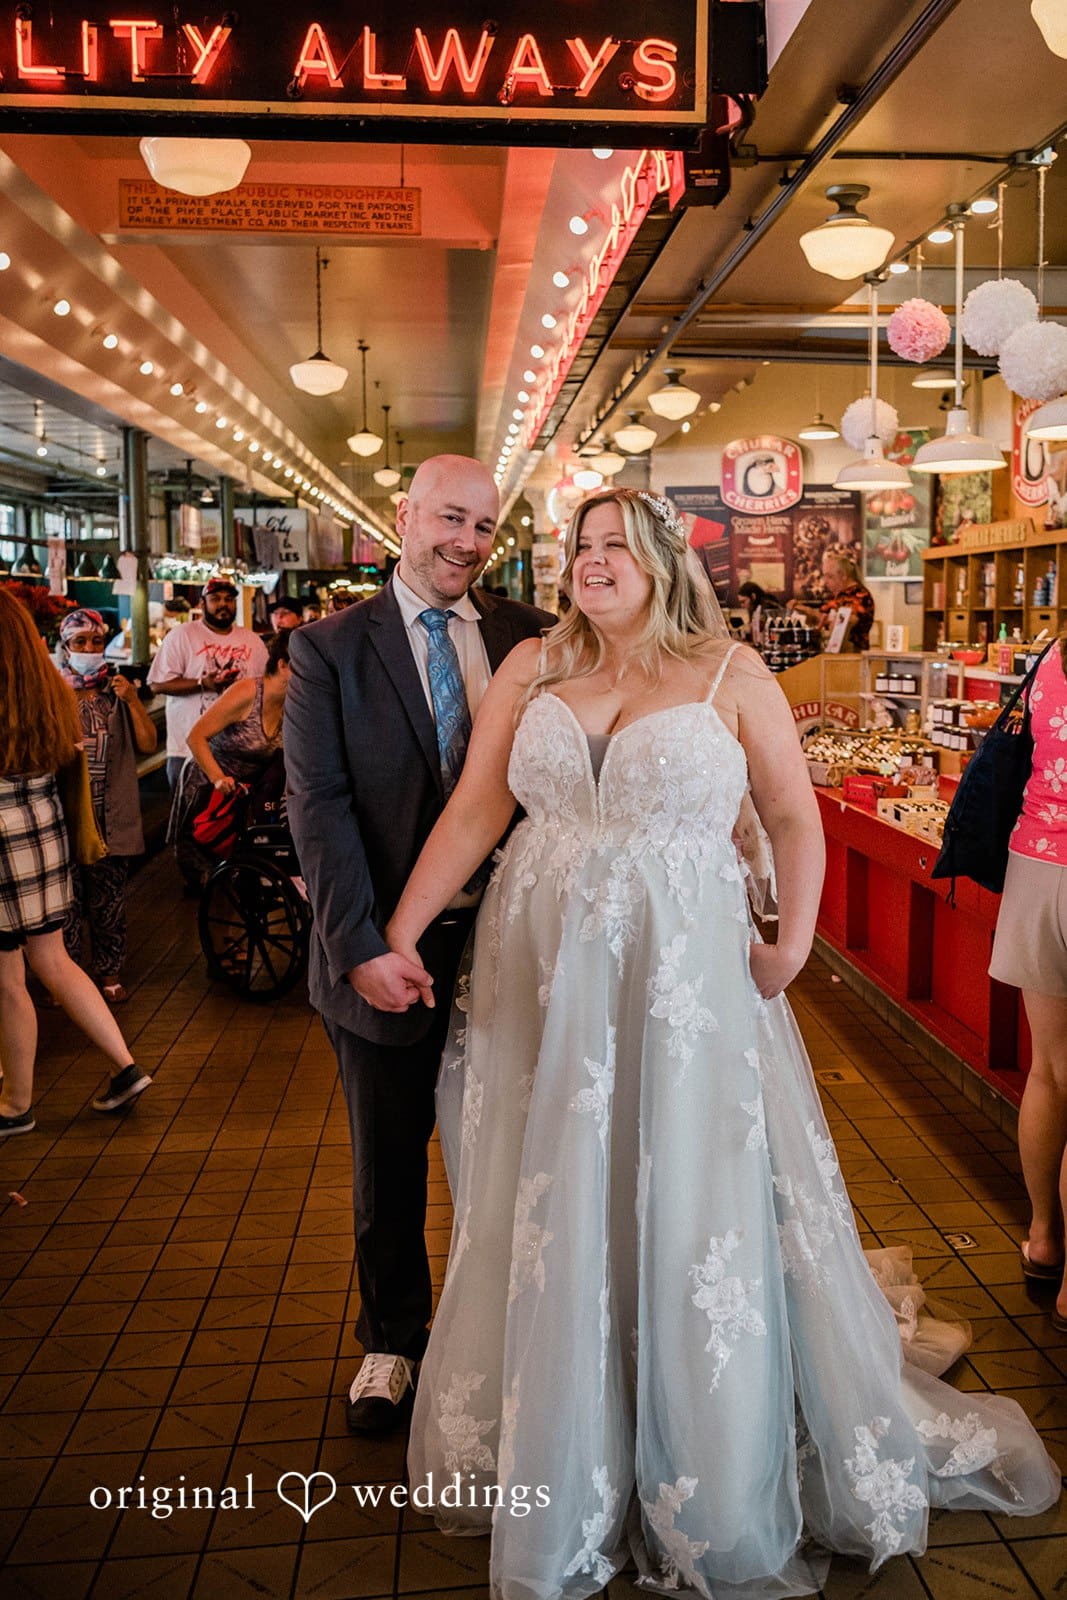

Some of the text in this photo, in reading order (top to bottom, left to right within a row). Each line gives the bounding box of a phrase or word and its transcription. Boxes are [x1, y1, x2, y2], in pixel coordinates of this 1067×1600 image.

[0, 18, 679, 102] LITY ALWAYS
[127, 184, 158, 195] THIS
[237, 186, 289, 199] PUBLIC
[296, 187, 414, 201] THOROUGHFARE
[127, 196, 415, 212] IT IS A PRIVATE WALK RESERVED FOR THE PATRONS
[127, 206, 143, 214] OF
[149, 206, 171, 215] THE
[176, 207, 205, 216] PIKE
[211, 208, 252, 217] PLACE
[257, 209, 299, 218] PUBLIC
[304, 210, 348, 219] MARKET
[371, 212, 391, 221] AND
[394, 212, 413, 221] THE
[128, 215, 172, 224] FAIRLEY
[177, 217, 243, 226] INVESTMENT
[268, 219, 287, 227] AND
[291, 220, 319, 228] THEIR
[323, 220, 371, 230] RESPECTIVE
[375, 222, 414, 230] TENANTS
[726, 488, 798, 511] CHERRIES
[279, 552, 300, 562] LES
[792, 703, 858, 726] HUKAR
